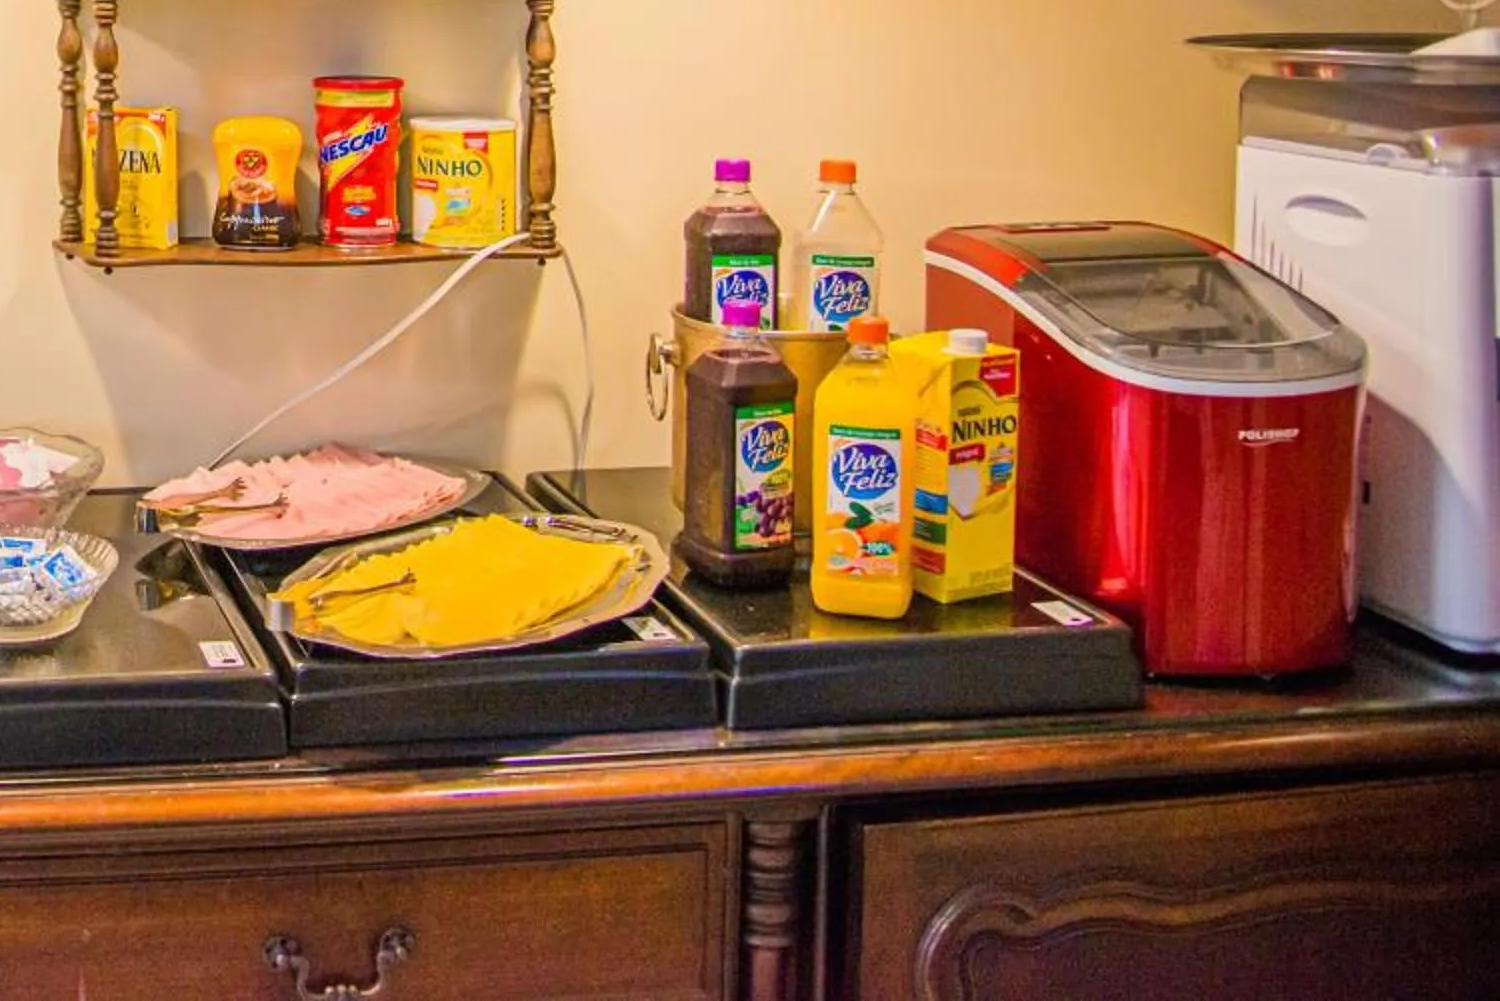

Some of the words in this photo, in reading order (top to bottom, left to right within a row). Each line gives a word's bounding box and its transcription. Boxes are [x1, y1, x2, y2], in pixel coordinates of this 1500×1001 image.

[320, 121, 390, 164] NESCAU
[91, 148, 161, 175] ZENA
[417, 156, 483, 177] NINHO
[717, 274, 763, 299] Viva
[815, 274, 864, 301] Viva
[820, 293, 869, 320] Feliz
[740, 426, 787, 453] Viva
[951, 414, 1017, 443] NINHO
[746, 441, 790, 472] Feliz
[833, 446, 888, 473] Viva
[839, 469, 896, 496] Feliz
